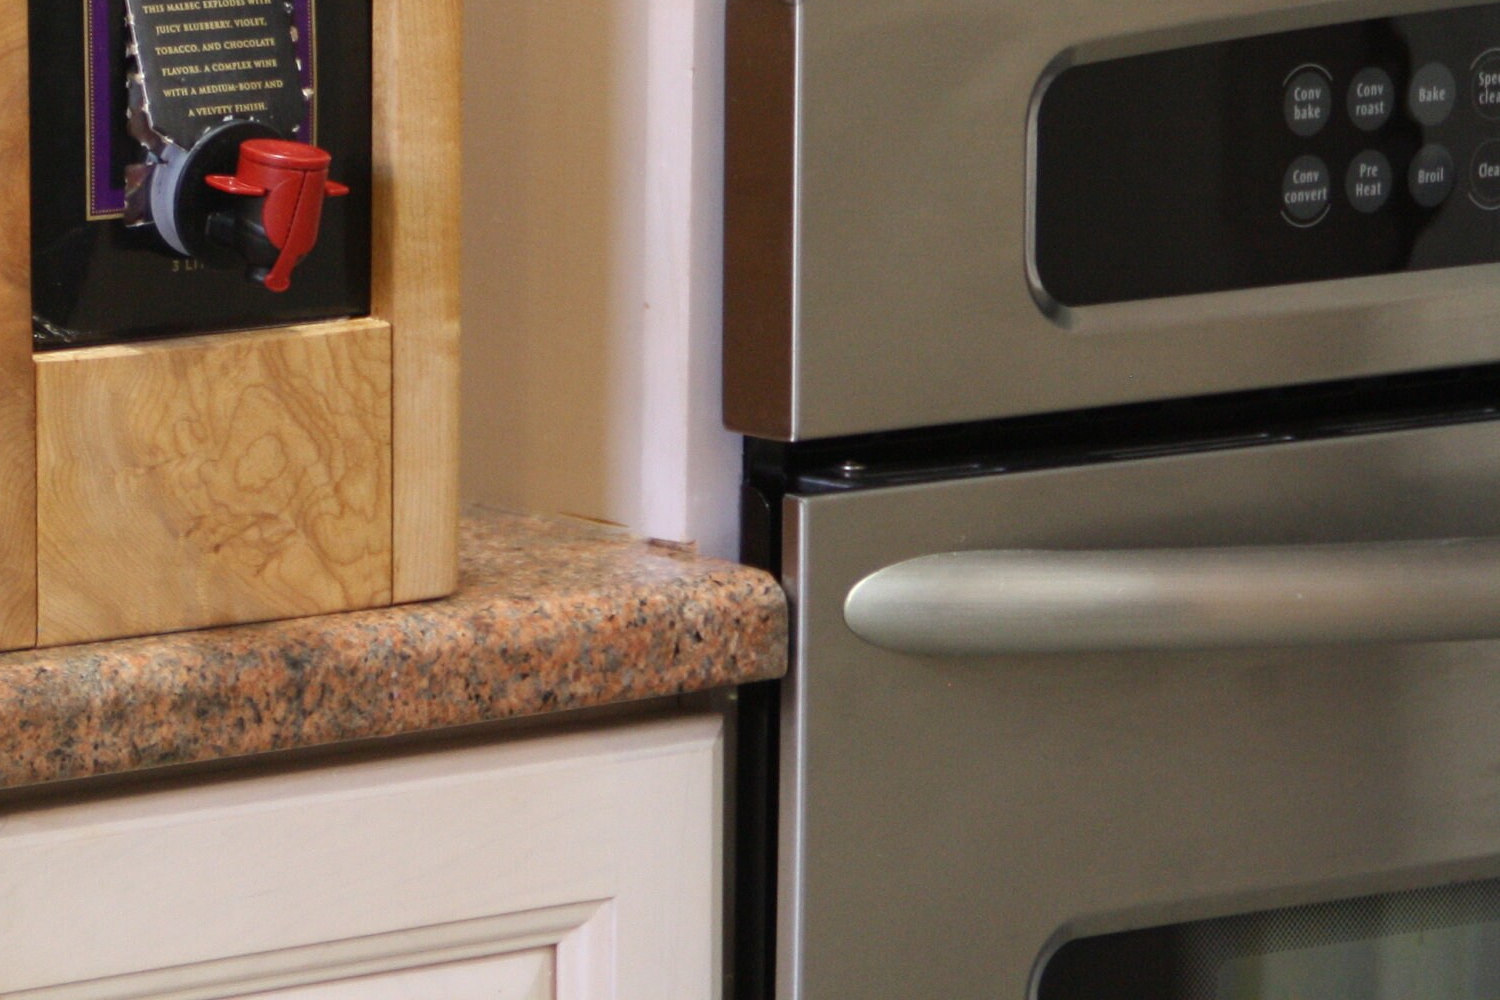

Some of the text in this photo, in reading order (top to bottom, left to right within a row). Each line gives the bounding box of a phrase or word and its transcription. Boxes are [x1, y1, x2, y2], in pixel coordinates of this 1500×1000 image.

[142, 4, 165, 14] THIS
[166, 1, 200, 12] MALBEC
[155, 24, 181, 36] JUICY
[202, 42, 221, 52] AND
[223, 37, 276, 50] CHOCOLATE
[204, 65, 211, 73] A
[211, 61, 253, 73] COMPLEX
[253, 58, 278, 68] WINE
[163, 80, 284, 98] WITH A MEDIUM-BODY AND
[1293, 86, 1321, 100] Conv
[1356, 83, 1384, 98] Conv
[1418, 86, 1446, 102] Bake
[187, 108, 195, 118] A
[195, 104, 233, 116] VELVETY
[1293, 104, 1321, 120] bake
[1355, 101, 1384, 116] roast
[1292, 169, 1320, 184] Conv
[1359, 163, 1378, 178] Pre
[1417, 167, 1444, 184] Broil
[1284, 188, 1328, 204] convert
[1355, 181, 1382, 197] Heat
[172, 260, 180, 272] 3
